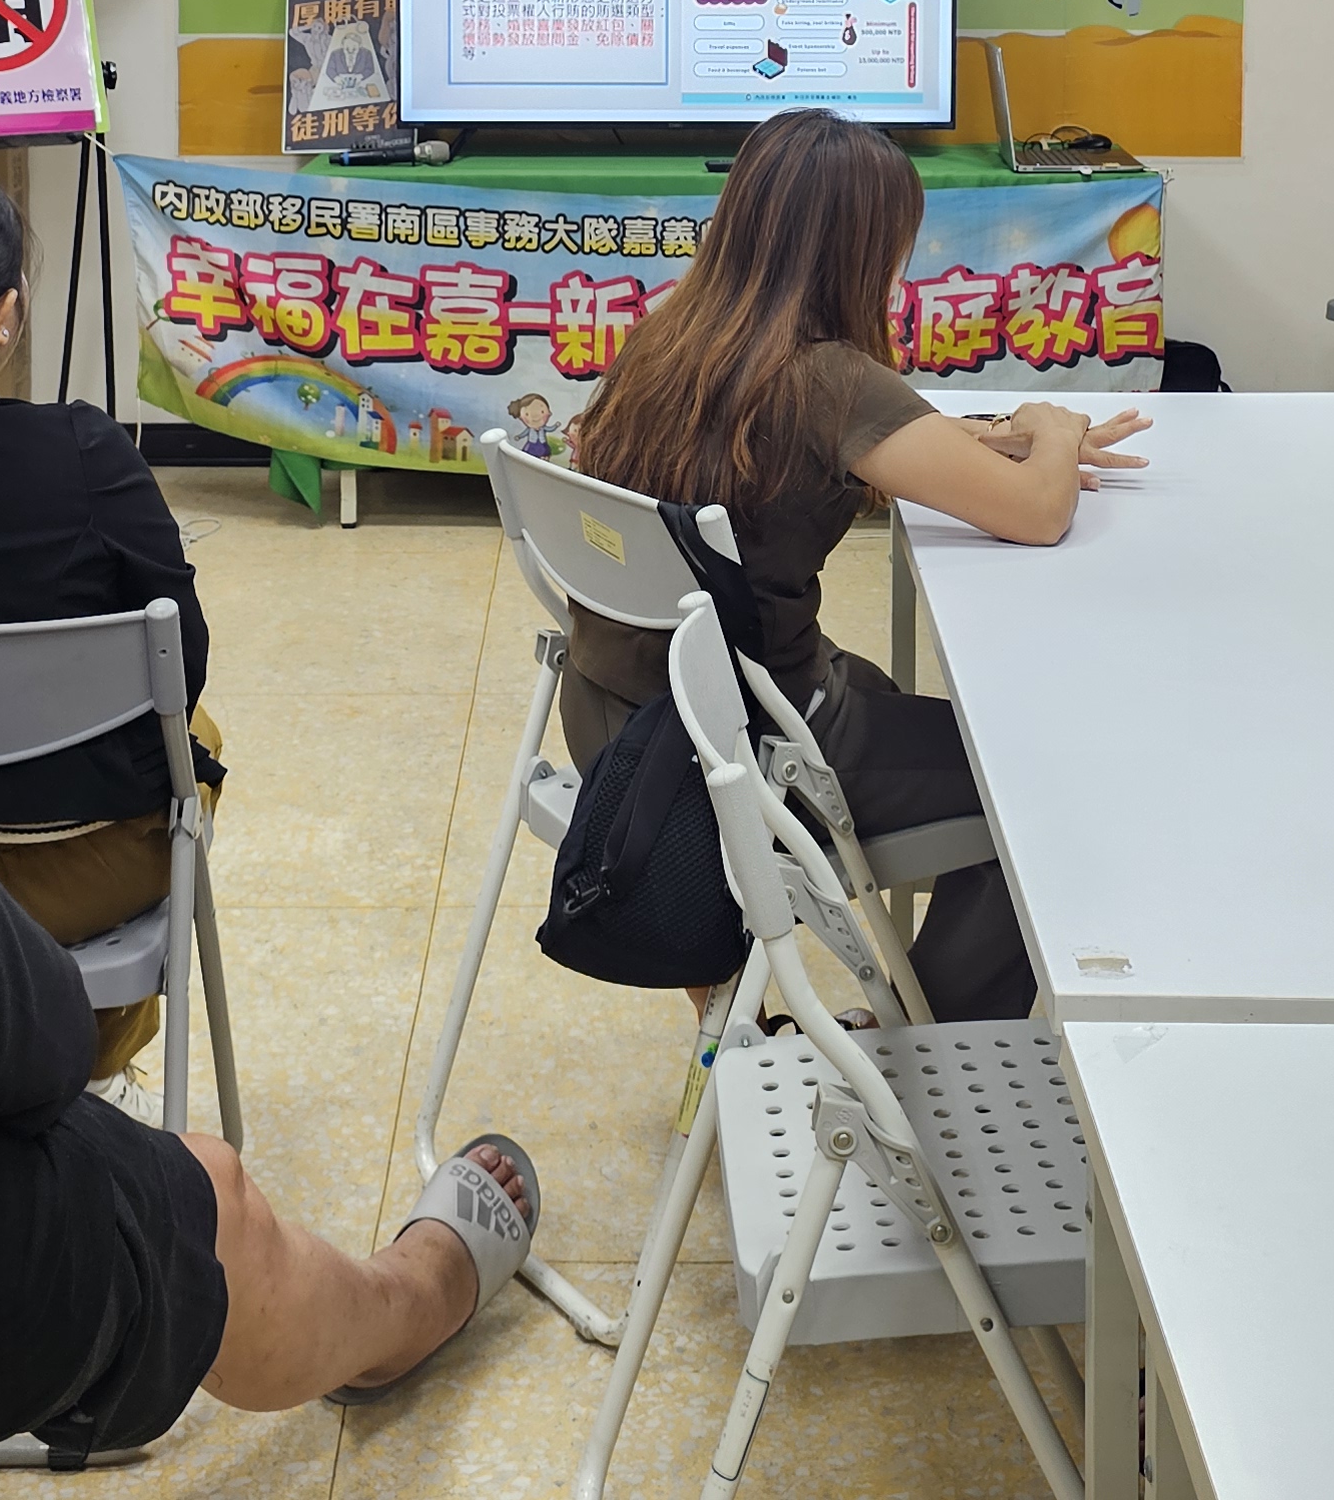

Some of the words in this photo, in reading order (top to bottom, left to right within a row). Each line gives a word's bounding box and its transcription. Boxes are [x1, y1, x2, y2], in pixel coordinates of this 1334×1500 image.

[153, 180, 713, 257] 內政部移民署南區事務大隊嘉義
[449, 1162, 521, 1242] adidas
